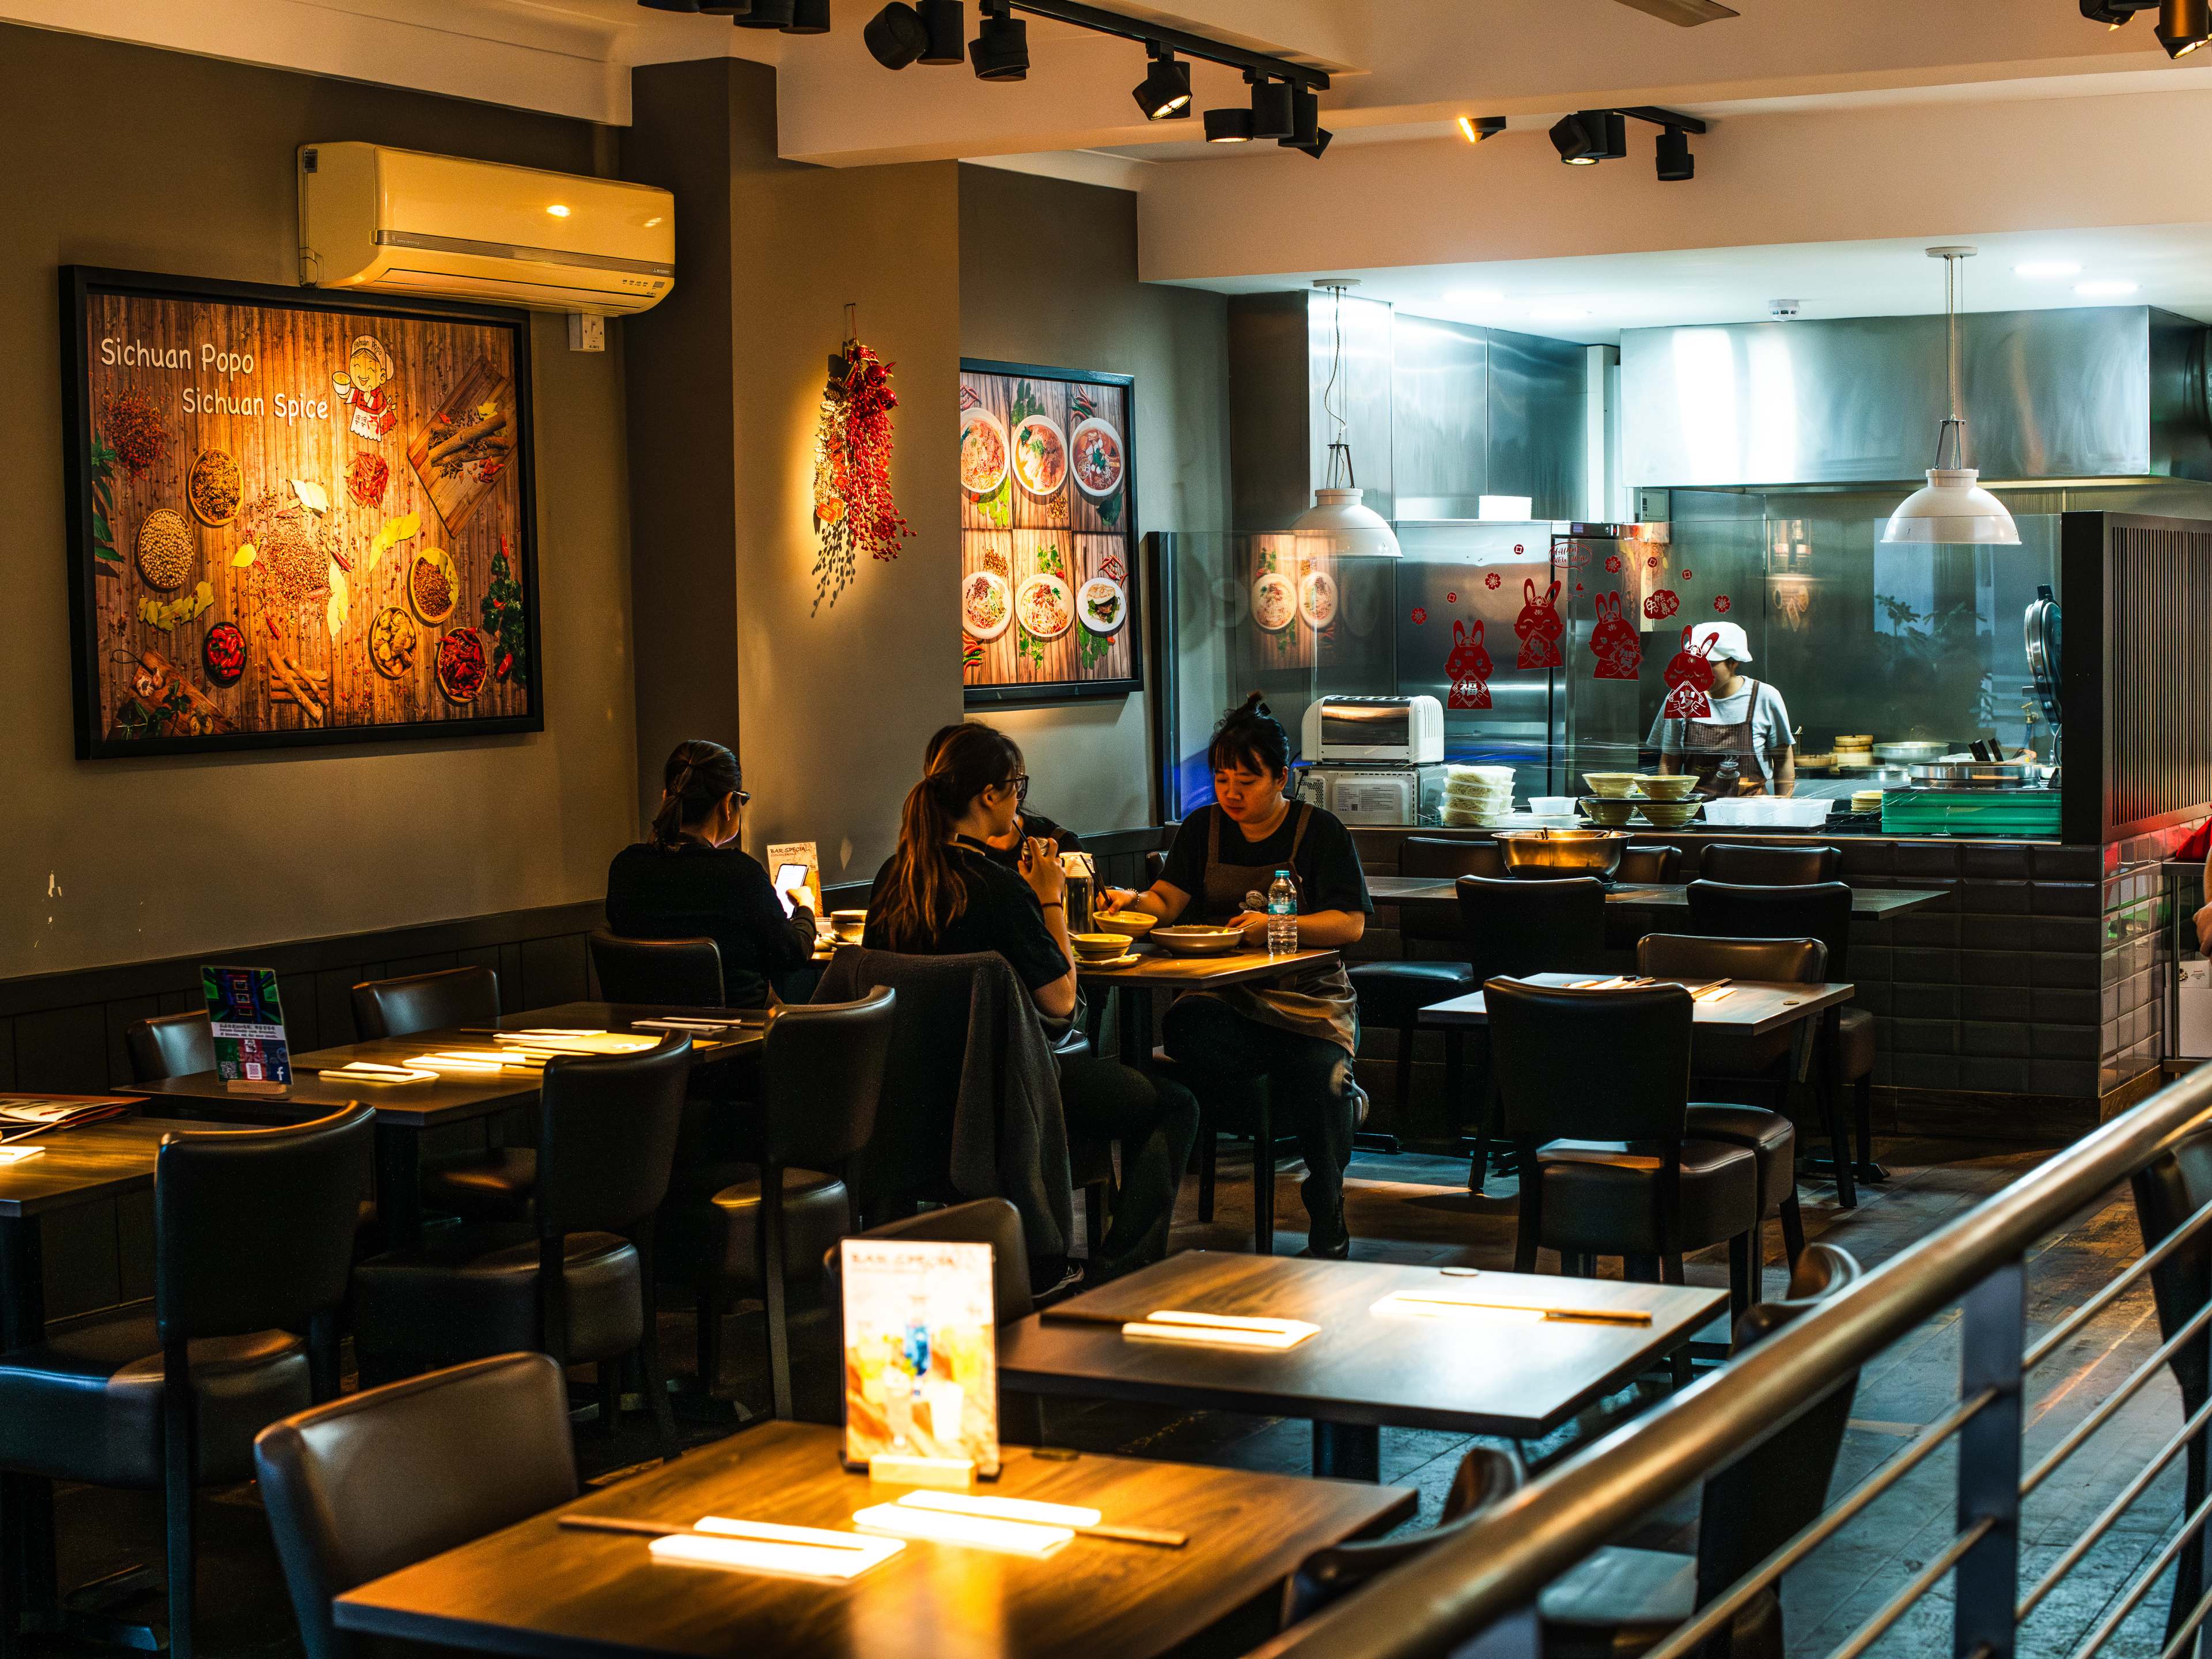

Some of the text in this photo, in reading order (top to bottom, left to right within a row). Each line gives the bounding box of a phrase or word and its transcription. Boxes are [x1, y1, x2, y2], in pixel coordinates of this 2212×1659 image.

[101, 338, 255, 381] Sichuan Popo
[182, 388, 329, 426] Sichuan Spice
[1460, 679, 1478, 696] 福
[1679, 689, 1695, 709] 岁
